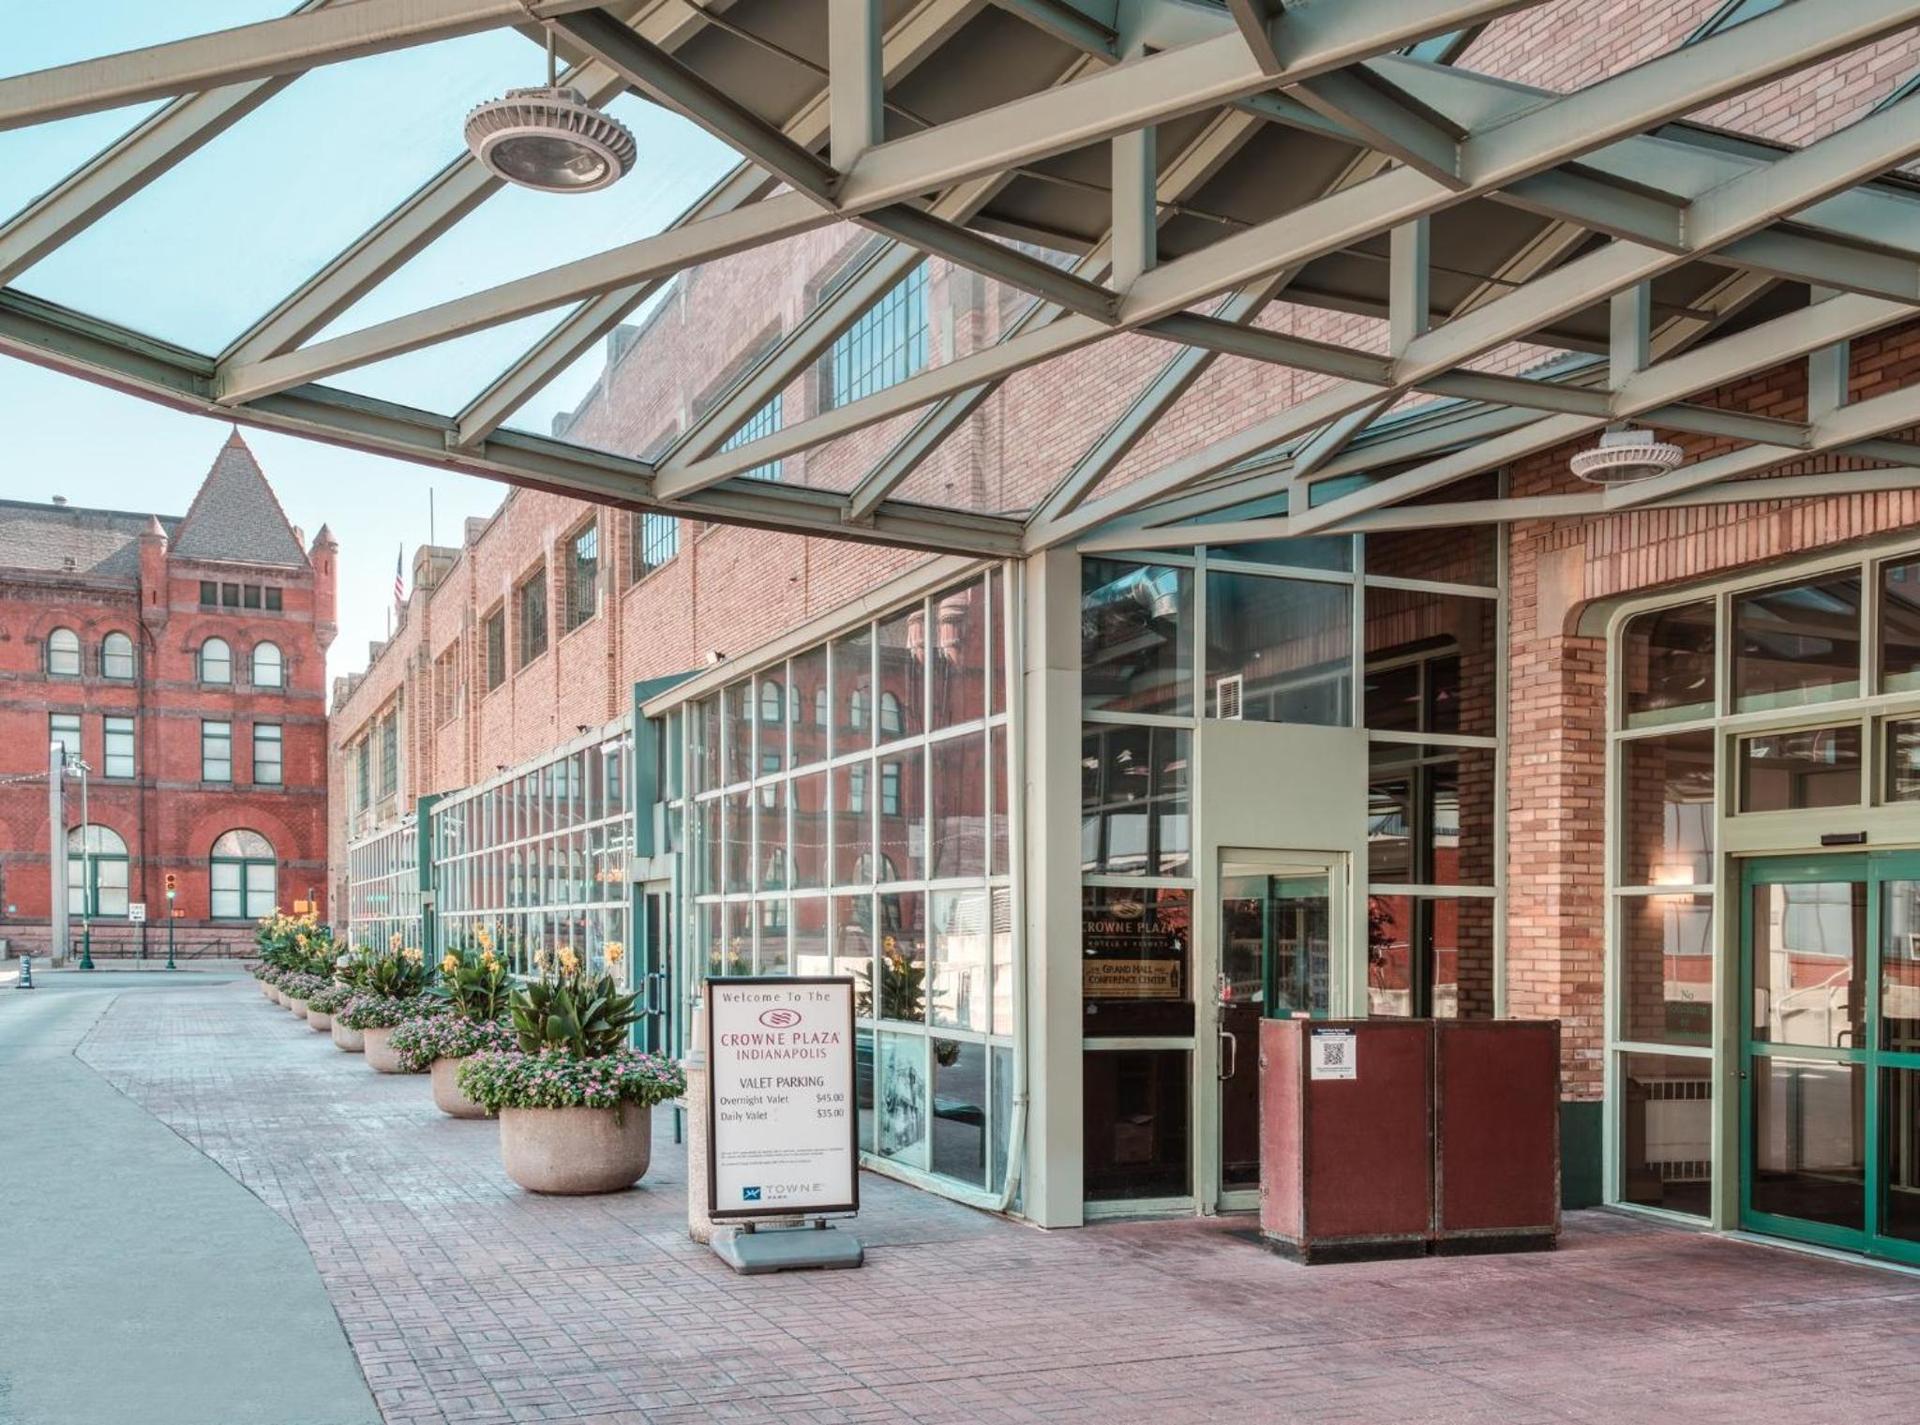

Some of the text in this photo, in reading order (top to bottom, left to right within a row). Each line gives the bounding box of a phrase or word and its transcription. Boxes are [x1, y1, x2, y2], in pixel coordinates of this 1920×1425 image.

[1137, 921, 1175, 933] PLAZA
[722, 991, 831, 1002] Welcome To The
[721, 1032, 840, 1047] CROWNE PLAZA
[736, 1047, 827, 1061] INDIANAPOLIS
[739, 1075, 825, 1089] VALET PARKING
[719, 1093, 845, 1106] Overnight Valet $45.00
[720, 1108, 845, 1122] Daily Valet $35.00
[767, 1183, 822, 1193] TOWNE
